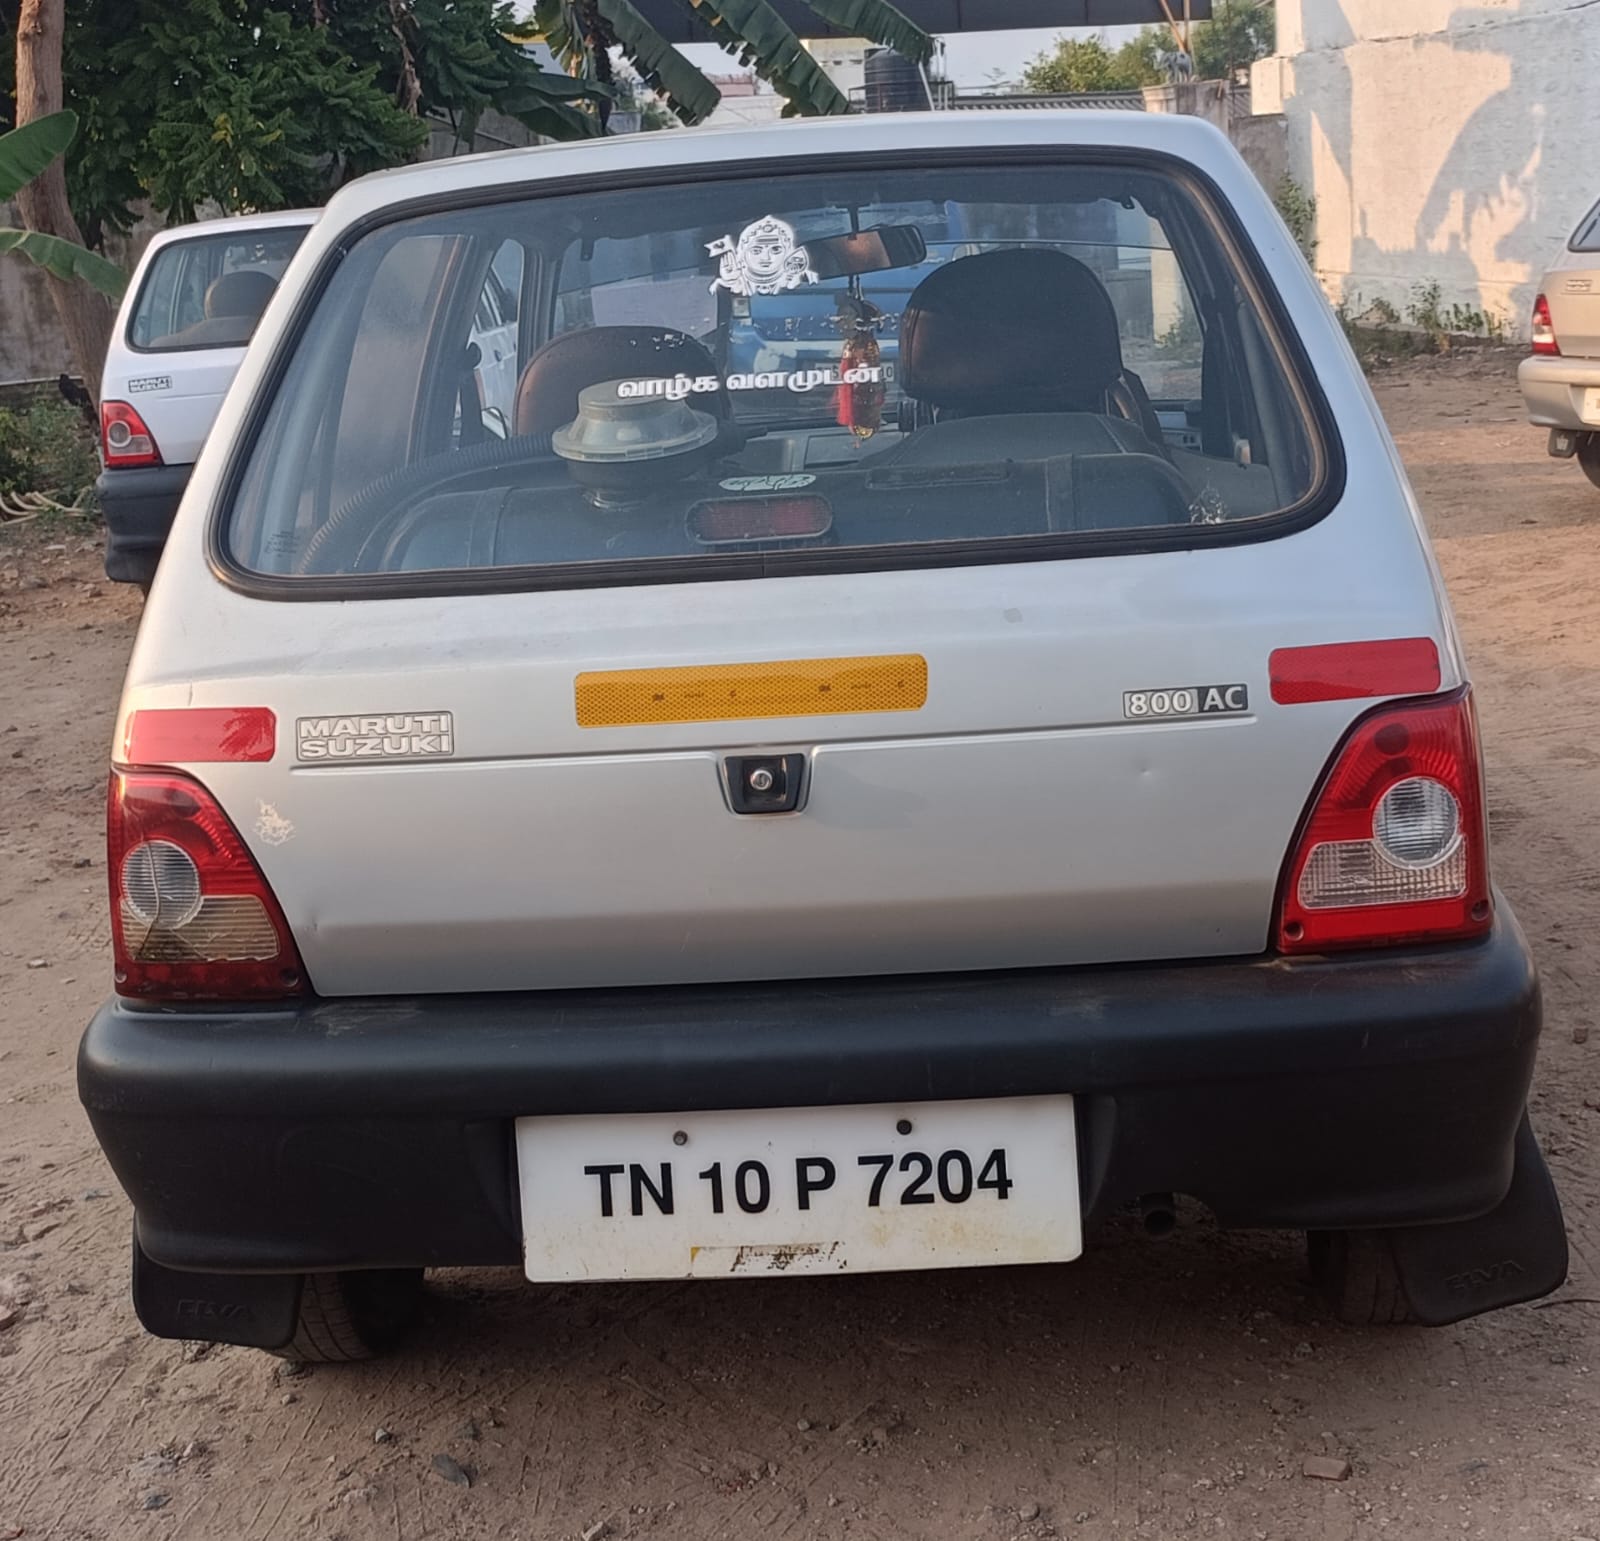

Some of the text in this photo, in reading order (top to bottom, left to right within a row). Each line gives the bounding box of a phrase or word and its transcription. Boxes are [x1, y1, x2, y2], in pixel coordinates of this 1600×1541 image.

[617, 373, 719, 400] வாழ்க
[726, 363, 881, 392] வளமுடன்
[1130, 686, 1243, 715] 800 AC
[300, 715, 449, 738] MARUTI
[301, 735, 449, 758] SUZUKI
[584, 1149, 1013, 1217] TN 10 P 7204
[1446, 1259, 1526, 1289] ELVA
